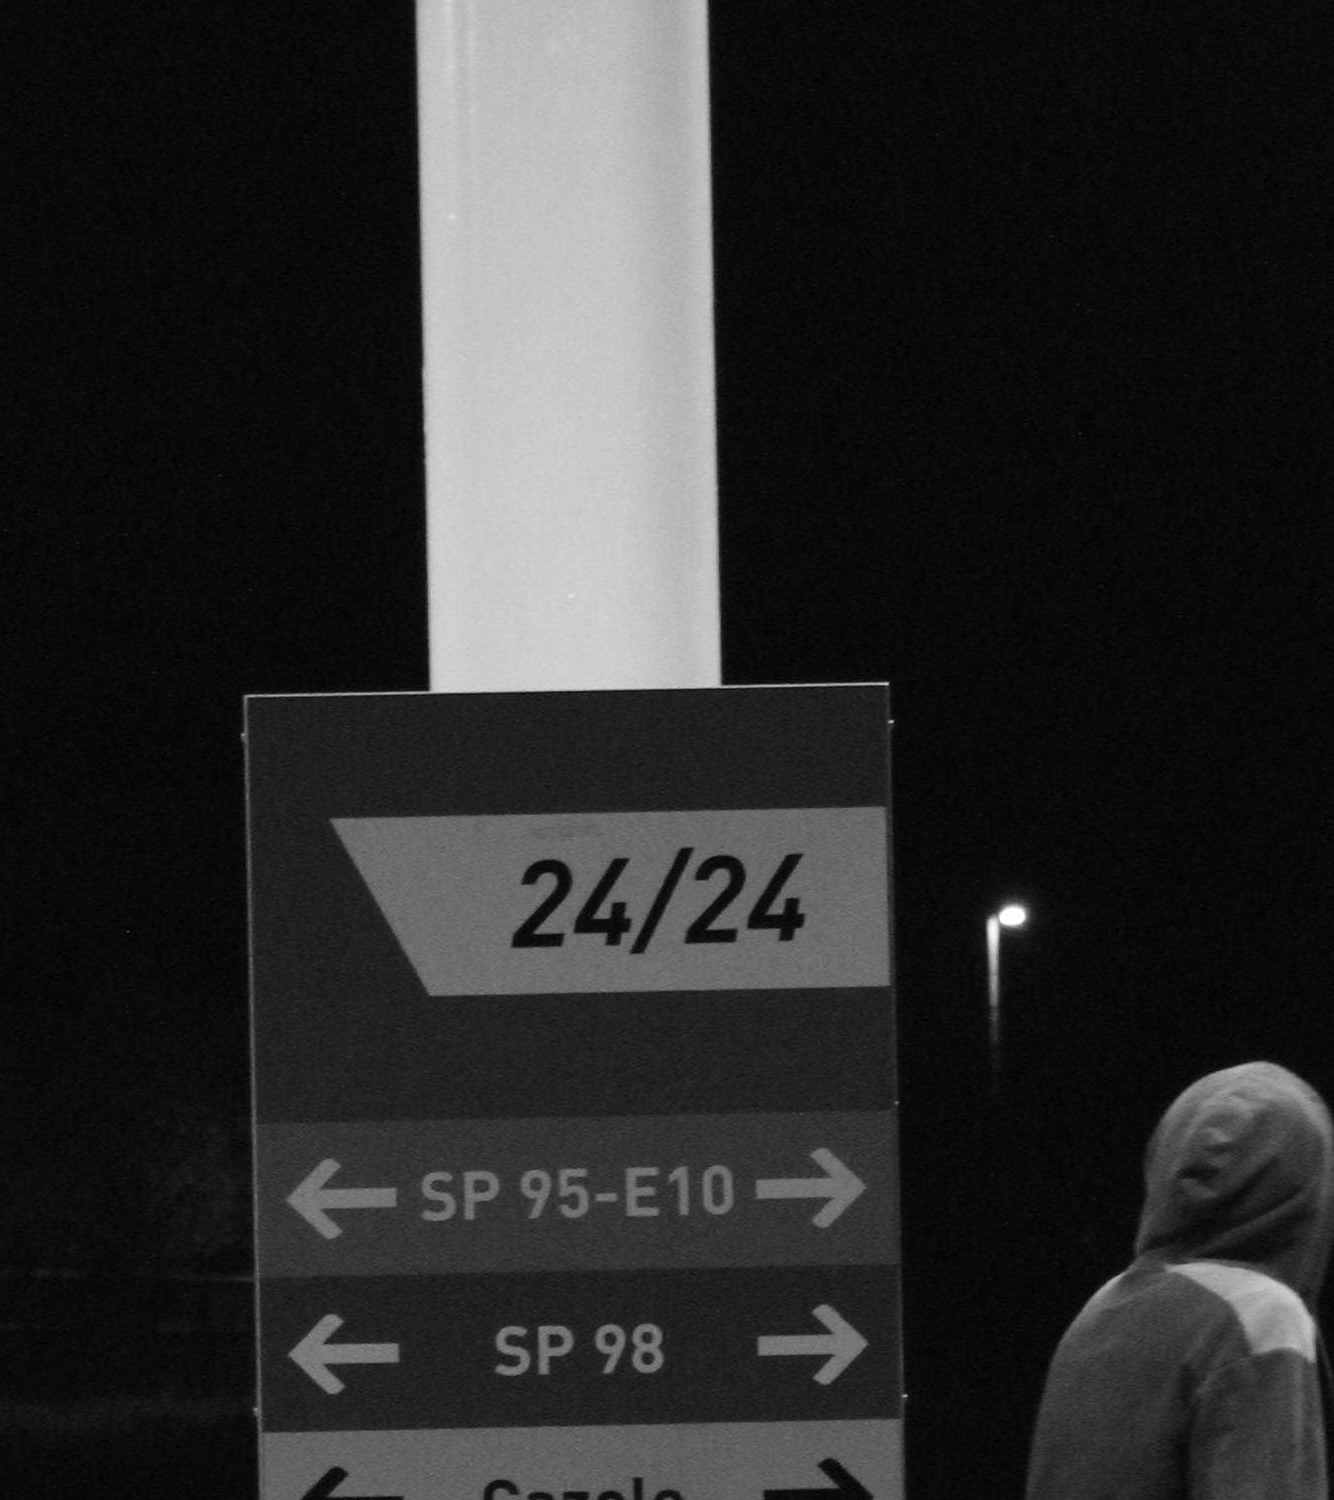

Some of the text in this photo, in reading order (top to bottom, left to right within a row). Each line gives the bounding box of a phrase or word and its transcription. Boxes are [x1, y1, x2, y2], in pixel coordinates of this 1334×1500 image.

[511, 846, 806, 955] 24/24
[420, 1164, 734, 1222] SP 95-E10
[493, 1323, 665, 1377] SP 98
